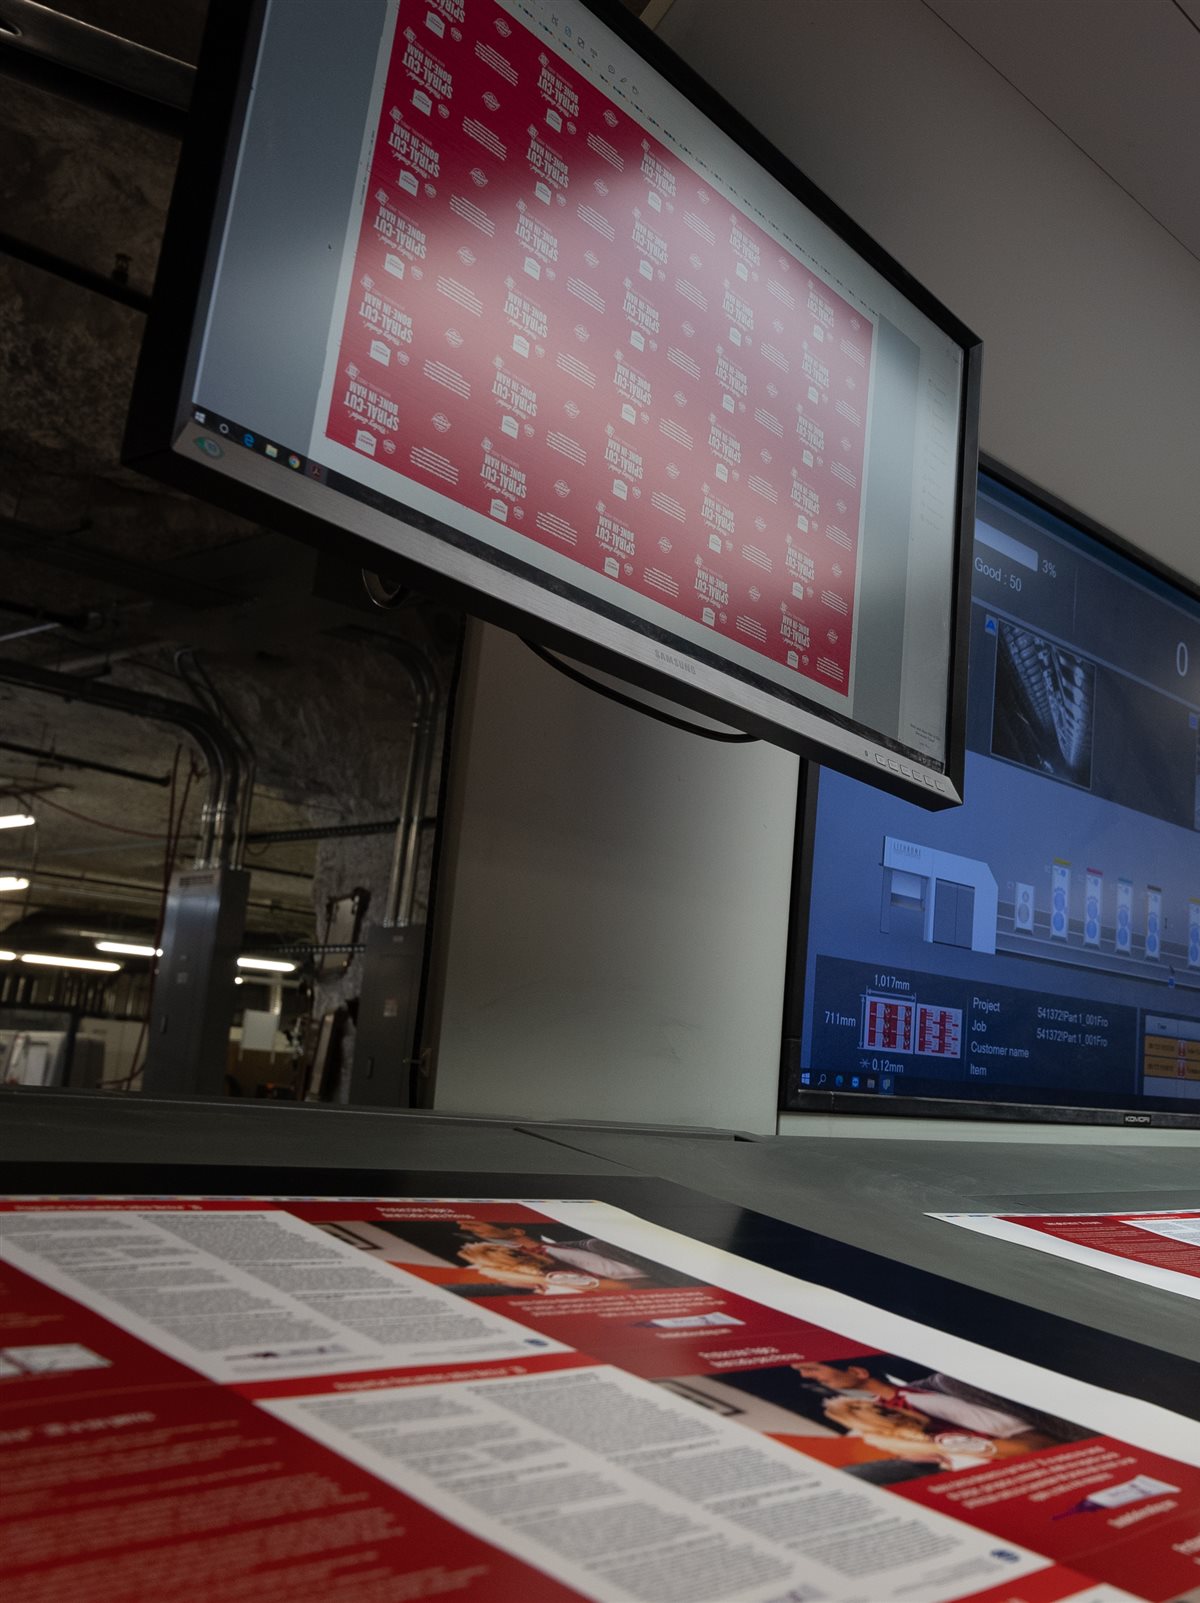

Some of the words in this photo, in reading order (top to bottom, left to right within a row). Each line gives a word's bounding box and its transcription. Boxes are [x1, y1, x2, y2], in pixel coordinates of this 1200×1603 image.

[407, 42, 423, 62] HAM
[402, 50, 452, 99] SPIRAL-CUT
[537, 73, 578, 117] SPIRAL-CUT
[393, 122, 409, 142] HAM
[388, 130, 439, 178] SPIRAL-CUT
[526, 146, 568, 188] SPIRAL-CUT
[378, 205, 395, 224] HAM
[373, 213, 426, 259] SPIRAL-CUT
[514, 221, 558, 262] SPIRAL-CUT
[364, 290, 381, 310] HAM
[358, 300, 412, 344] SPIRAL-CUT
[503, 298, 547, 338] SPIRAL-CUT
[349, 380, 367, 398] HAM
[491, 379, 537, 417] SPIRAL-CUT
[343, 389, 399, 432] SPIRAL-CUT
[480, 462, 526, 498] SPIRAL-CUT
[974, 557, 1002, 582] Good
[1009, 574, 1022, 592] 50
[654, 649, 696, 675] SAMSUNG
[1176, 641, 1188, 677] 0
[824, 1011, 857, 1027] 711mm
[973, 997, 1000, 1014] Project
[971, 1019, 987, 1033] Job
[872, 1058, 904, 1073] 0.12mm
[970, 1041, 1008, 1056] Customer
[1009, 1049, 1030, 1058] name
[970, 1064, 987, 1076] Item
